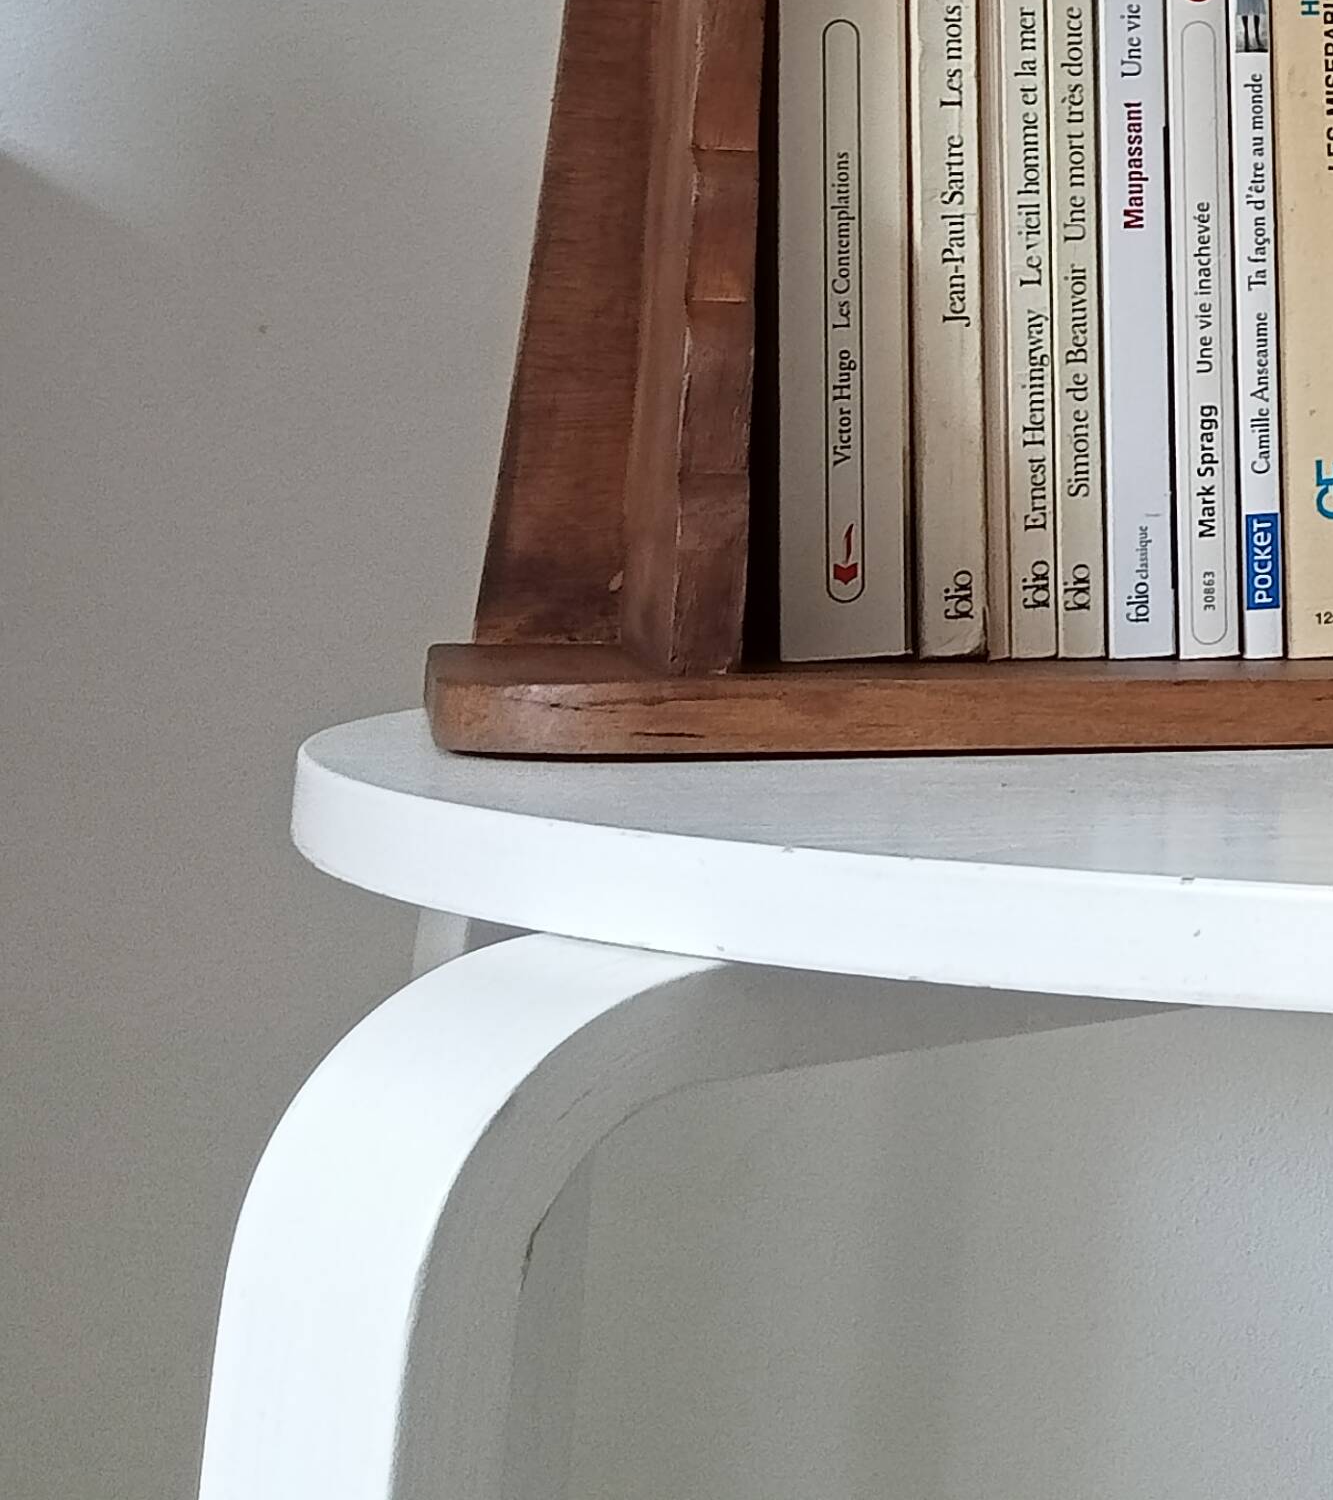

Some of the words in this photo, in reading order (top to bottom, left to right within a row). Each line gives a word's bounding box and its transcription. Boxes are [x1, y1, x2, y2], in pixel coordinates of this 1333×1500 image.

[943, 4, 963, 60] mots
[1018, 6, 1036, 52] mer
[1060, 6, 1083, 76] douce
[1120, 3, 1142, 31] vie
[1015, 58, 1037, 77] la
[1121, 34, 1143, 78] Une
[939, 67, 963, 109] Les
[1016, 83, 1038, 106] et
[1061, 83, 1084, 125] très
[1242, 72, 1265, 130] monde
[941, 134, 965, 206] Sartre
[1016, 113, 1041, 194] homme
[1065, 128, 1085, 188] mort
[1123, 101, 1150, 230] Maupassant
[1250, 133, 1265, 156] au
[1245, 162, 1266, 210] d'être
[831, 151, 855, 295] Contemplations
[1017, 203, 1041, 251] vieil
[1063, 194, 1086, 243] Une
[1246, 215, 1271, 267] façon
[942, 213, 971, 328] Jean-Paul
[1019, 255, 1042, 287] Le
[1193, 201, 1212, 297] inachevée
[1247, 268, 1268, 291] Ta
[832, 299, 851, 330] Les
[1064, 263, 1088, 365] Beauvoir
[1193, 302, 1212, 331] vie
[832, 349, 856, 401] Hugo
[1022, 308, 1050, 448] Hemingway
[1196, 335, 1213, 375] Une
[1250, 311, 1269, 403] Anseaume
[1065, 372, 1088, 402] de
[833, 407, 852, 467] Victor
[1067, 409, 1090, 498] Simone
[1197, 404, 1219, 478] Spragg
[1250, 406, 1271, 475] Camille
[1024, 456, 1047, 532] Ernest
[1197, 484, 1217, 538] Mark
[944, 569, 974, 621] folio
[1022, 560, 1050, 611] folio
[1064, 563, 1091, 612] folio
[1126, 581, 1151, 624] folio
[1140, 525, 1153, 580] classique
[1203, 571, 1216, 611] 30863
